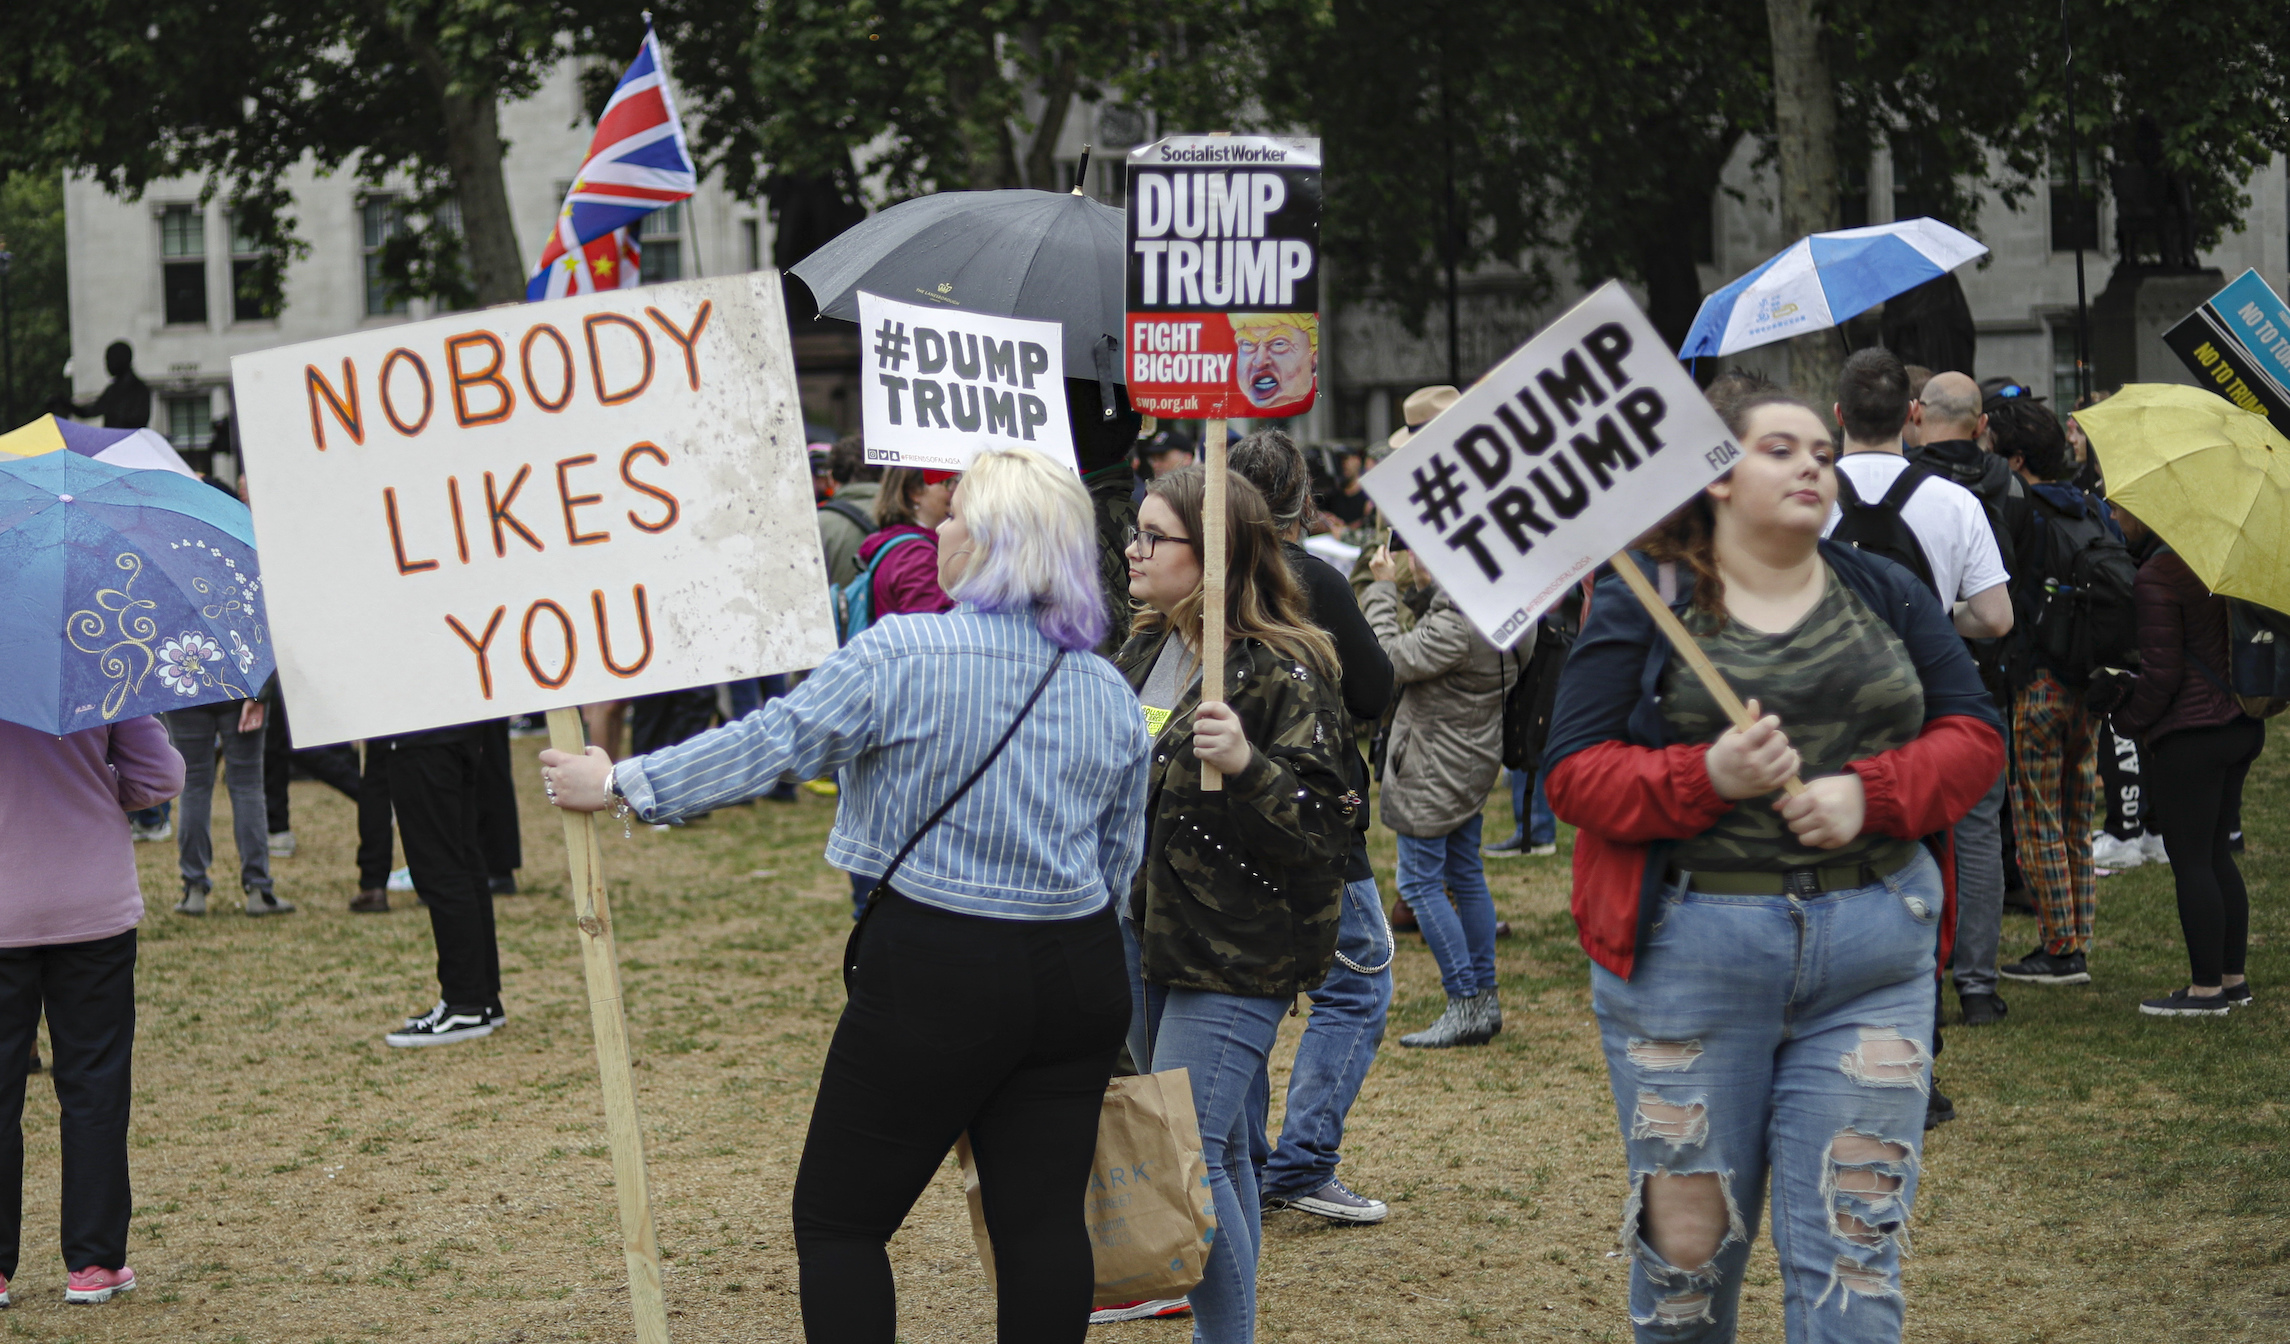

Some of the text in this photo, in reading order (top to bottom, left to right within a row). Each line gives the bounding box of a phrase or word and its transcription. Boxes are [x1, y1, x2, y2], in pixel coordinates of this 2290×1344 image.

[1138, 172, 1286, 239] DUMP
[1135, 240, 1312, 306] TRUMP
[874, 318, 1049, 390] #DUMP
[1133, 323, 1202, 352] FIGHT
[1133, 353, 1232, 383] BIGOTRY
[2193, 341, 2220, 367] NO
[2210, 360, 2235, 384] TO
[2237, 301, 2264, 327] NO
[2255, 320, 2279, 344] TO
[2269, 336, 2290, 374] TOR
[304, 299, 713, 452] NOBODY
[878, 373, 1048, 441] TRUMP
[1135, 395, 1199, 413] swp.org.uk
[1409, 322, 1634, 534] #DUMP
[1705, 439, 1740, 471] FOA
[383, 441, 680, 576] LIKES
[1445, 387, 1668, 584] TRUMP
[445, 583, 654, 700] YOU
[1090, 1162, 1151, 1193] ARK
